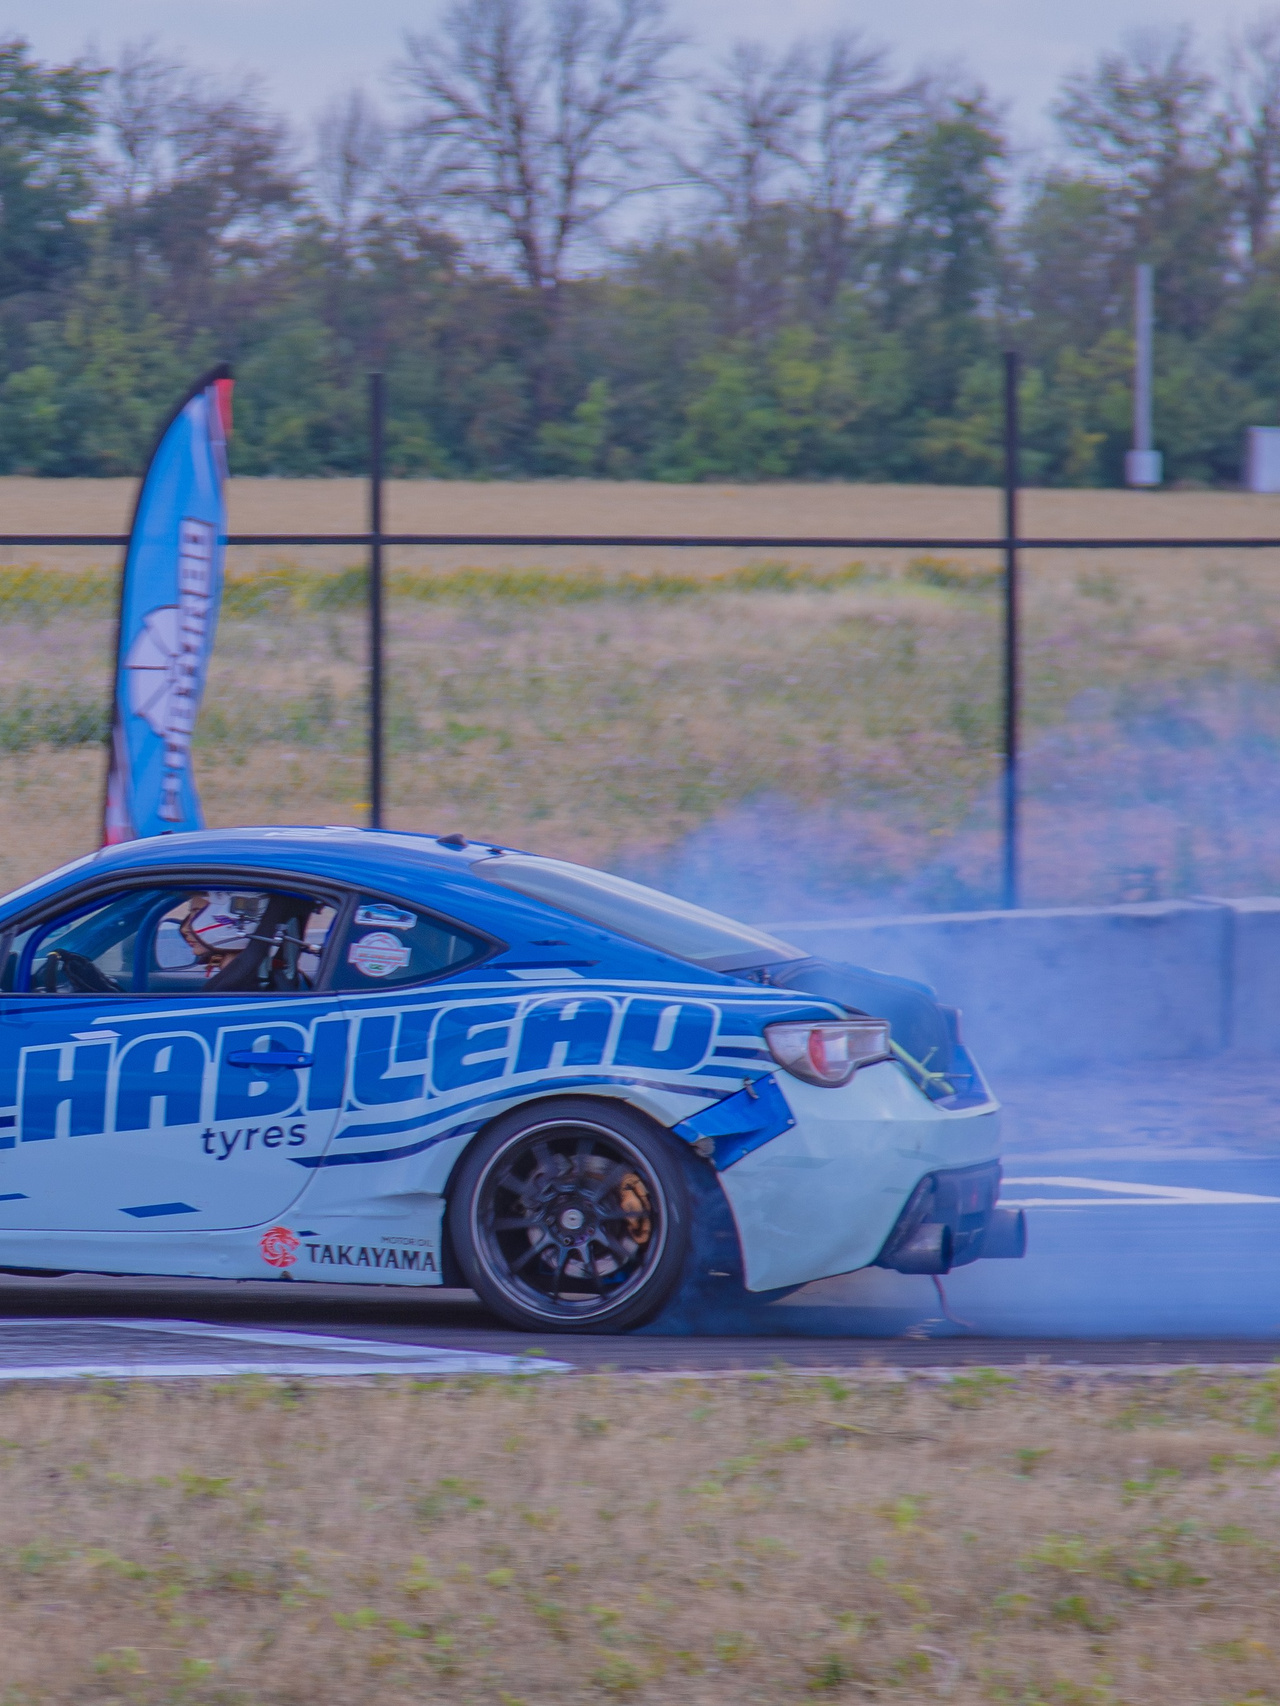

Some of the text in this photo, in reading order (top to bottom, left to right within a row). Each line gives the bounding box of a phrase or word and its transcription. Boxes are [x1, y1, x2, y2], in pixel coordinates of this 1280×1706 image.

[17, 995, 720, 1143] HABILEAD
[202, 1123, 308, 1161] tyres
[306, 1243, 438, 1272] TAKAYAMA
[381, 1236, 434, 1248] MOTOR OIL
